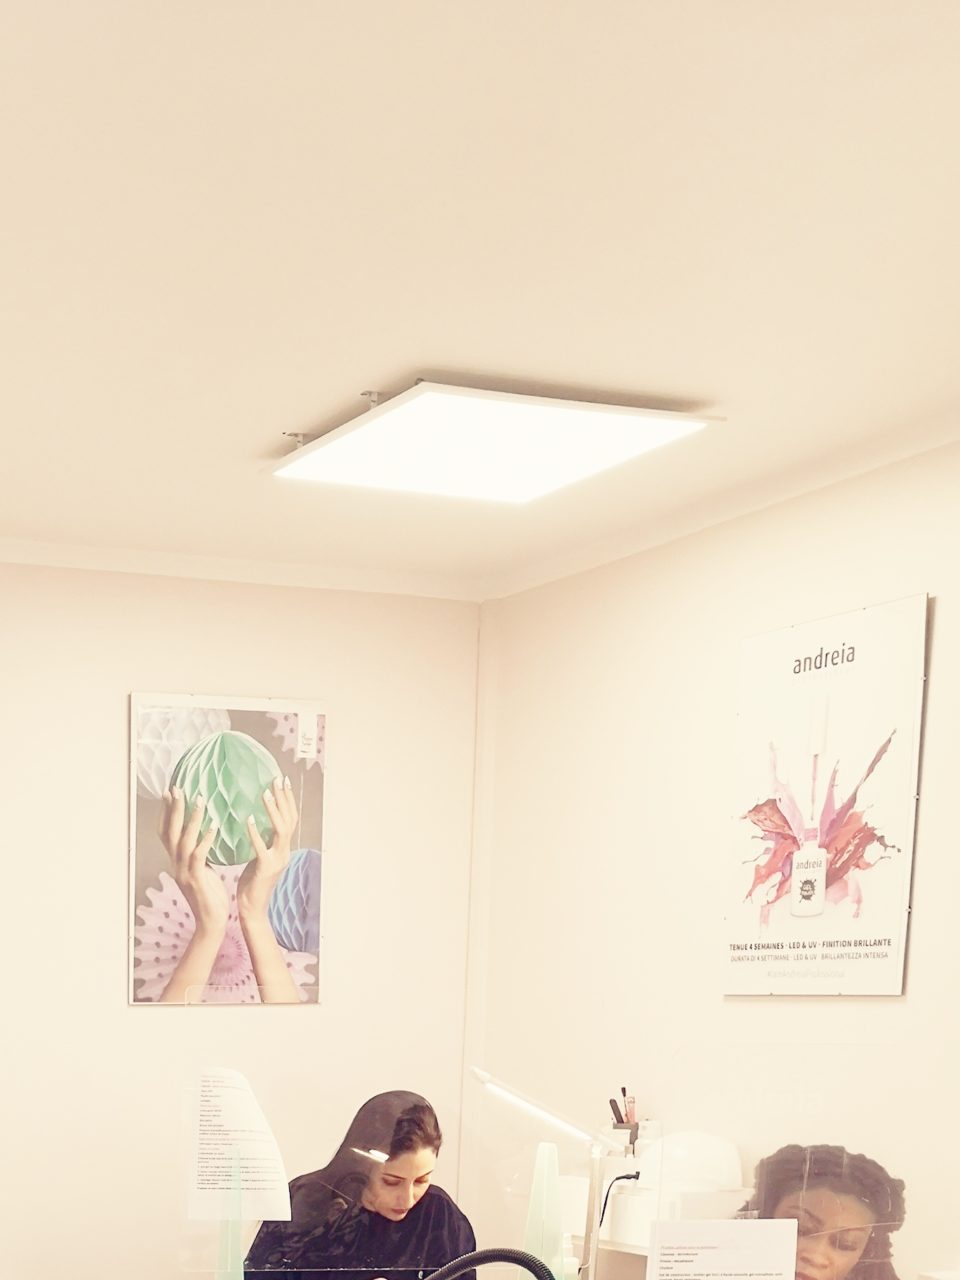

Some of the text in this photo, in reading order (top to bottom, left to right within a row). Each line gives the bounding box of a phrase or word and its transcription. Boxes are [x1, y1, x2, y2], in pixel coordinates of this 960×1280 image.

[793, 642, 855, 674] andreia
[795, 859, 823, 870] andreia
[729, 943, 748, 951] TENUE
[754, 942, 785, 951] SEMAINES
[808, 940, 818, 949] UV
[822, 940, 852, 948] FINITION
[853, 938, 892, 947] BRILLANTE
